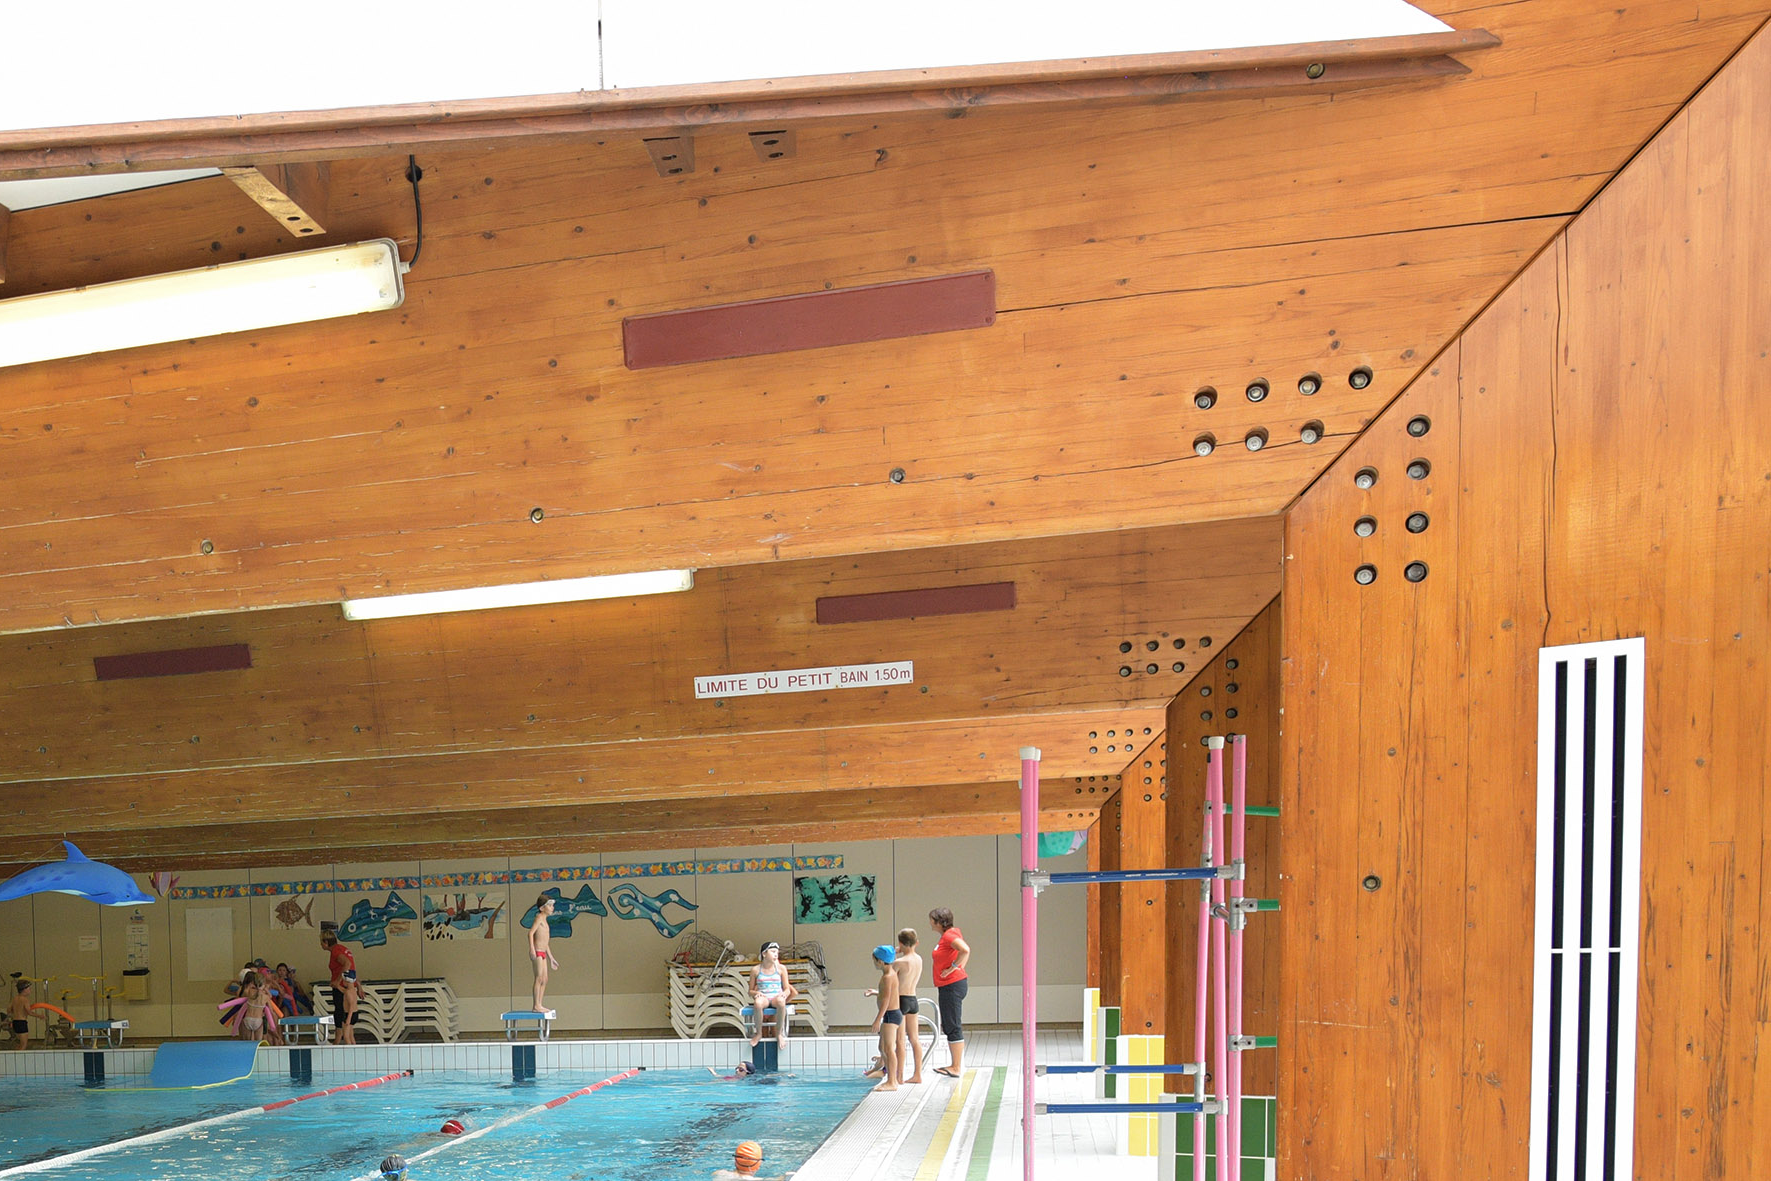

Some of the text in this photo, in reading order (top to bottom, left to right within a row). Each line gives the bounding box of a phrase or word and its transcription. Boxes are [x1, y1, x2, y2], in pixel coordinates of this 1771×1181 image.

[697, 679, 748, 694] LIMITE
[757, 677, 778, 690] DU
[788, 672, 832, 687] PETIT
[840, 670, 868, 684] BAIN
